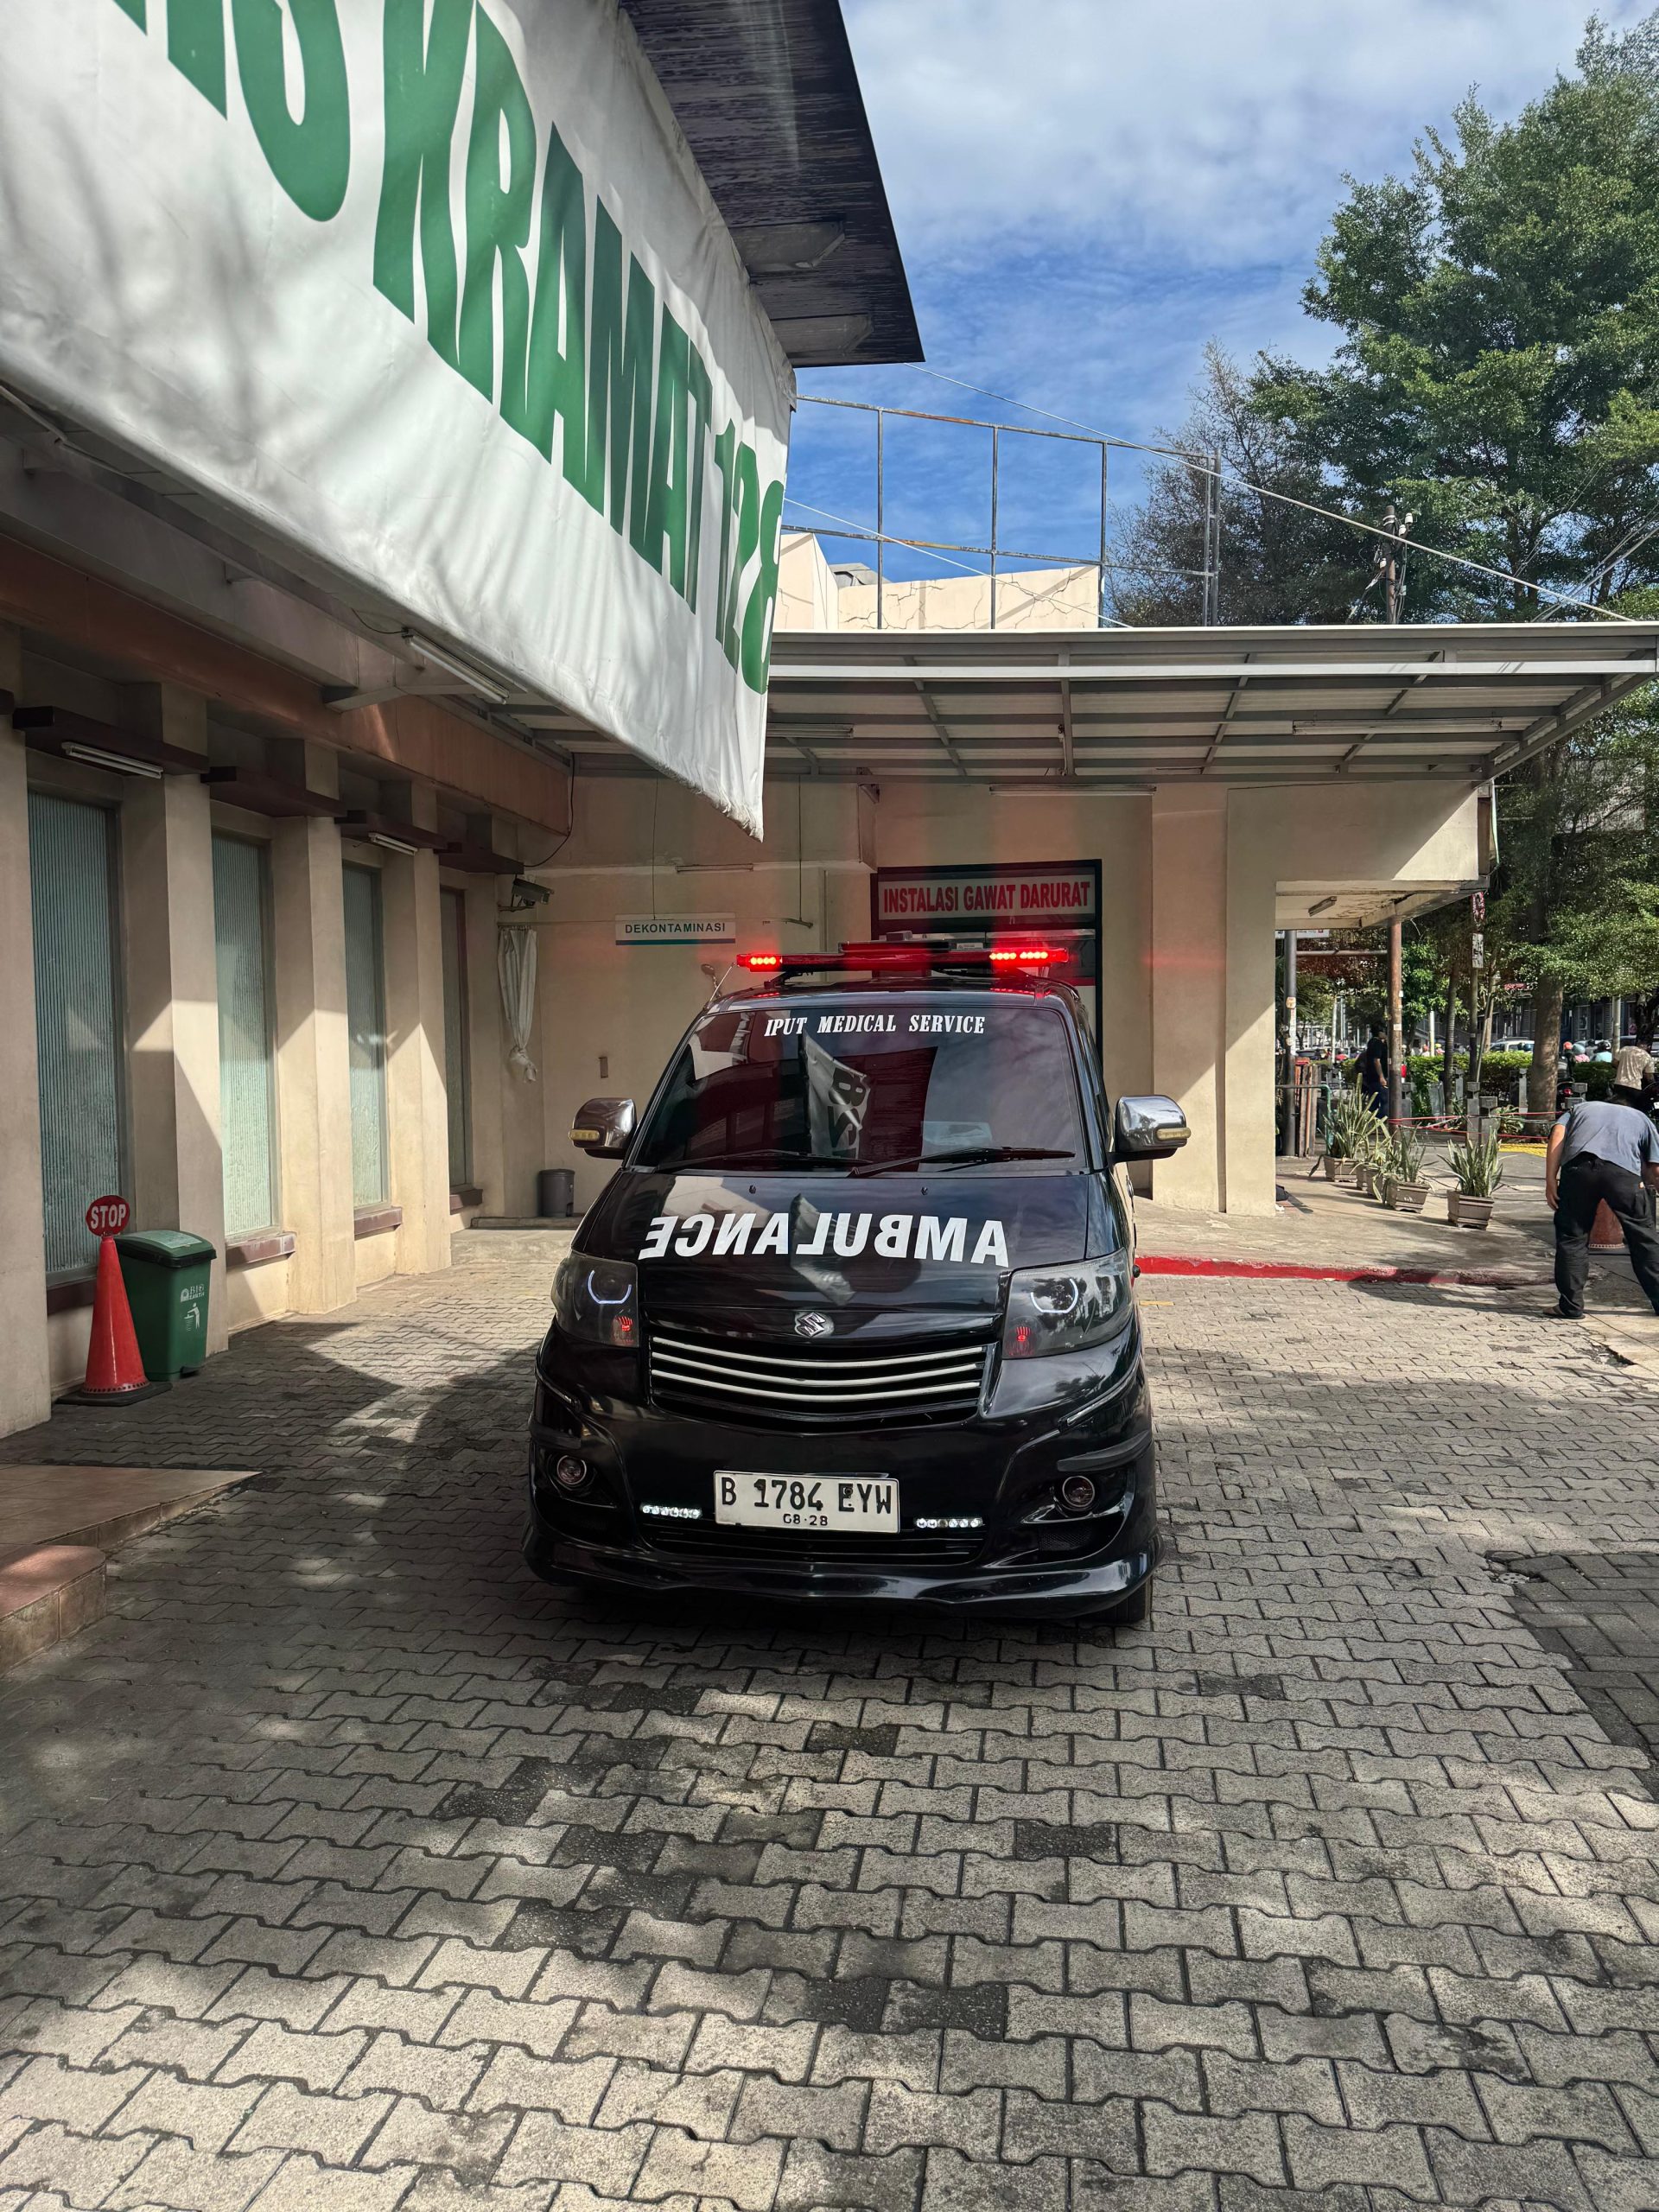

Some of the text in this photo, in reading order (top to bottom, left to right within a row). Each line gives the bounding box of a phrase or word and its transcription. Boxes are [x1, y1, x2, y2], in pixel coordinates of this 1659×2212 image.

[373, 0, 784, 695] KRAMAT 128
[883, 880, 1090, 913] INSTALASI GAWAT DARURAT
[625, 922, 726, 934] DEKONTAMINASI
[764, 1014, 986, 1037] IPUT MEDICAL SERVICE
[91, 1204, 127, 1230] STOP
[721, 1477, 892, 1515] B 1784 EYW
